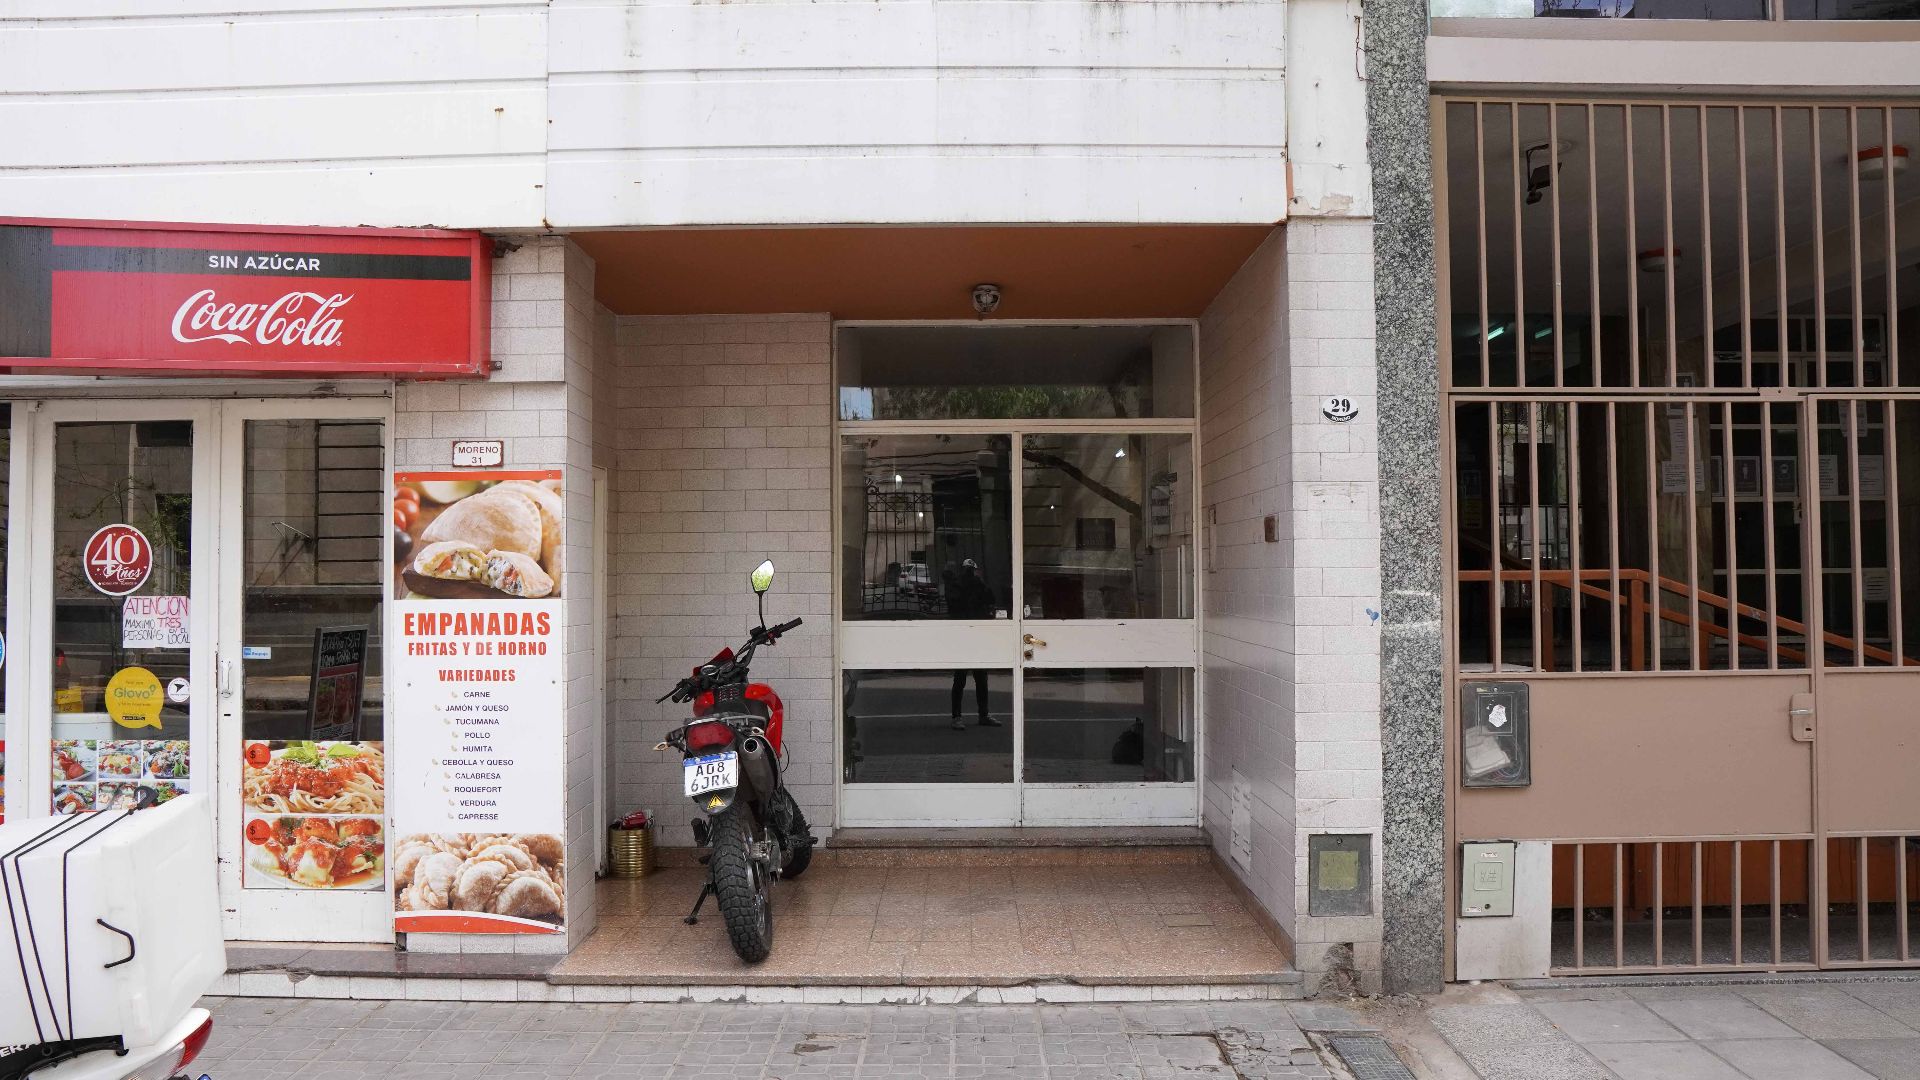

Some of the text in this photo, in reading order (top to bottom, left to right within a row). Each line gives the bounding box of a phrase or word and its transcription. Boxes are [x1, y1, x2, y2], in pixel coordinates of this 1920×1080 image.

[208, 254, 320, 271] SIN AZÚCAR
[171, 289, 355, 347] Coca-Cola
[1331, 398, 1350, 413] 29
[458, 446, 499, 454] MORENO
[471, 456, 482, 464] 31
[91, 533, 140, 578] 40
[157, 616, 182, 629] TRES
[404, 612, 551, 636] EMPANADAS
[167, 633, 191, 645] LOCAL
[408, 641, 547, 656] FRITAS Y DE HORNO
[438, 669, 516, 682] VARIEDADES
[113, 684, 156, 699] Glovo
[445, 703, 473, 712] JAMÓN
[691, 773, 730, 792] 6JRK
